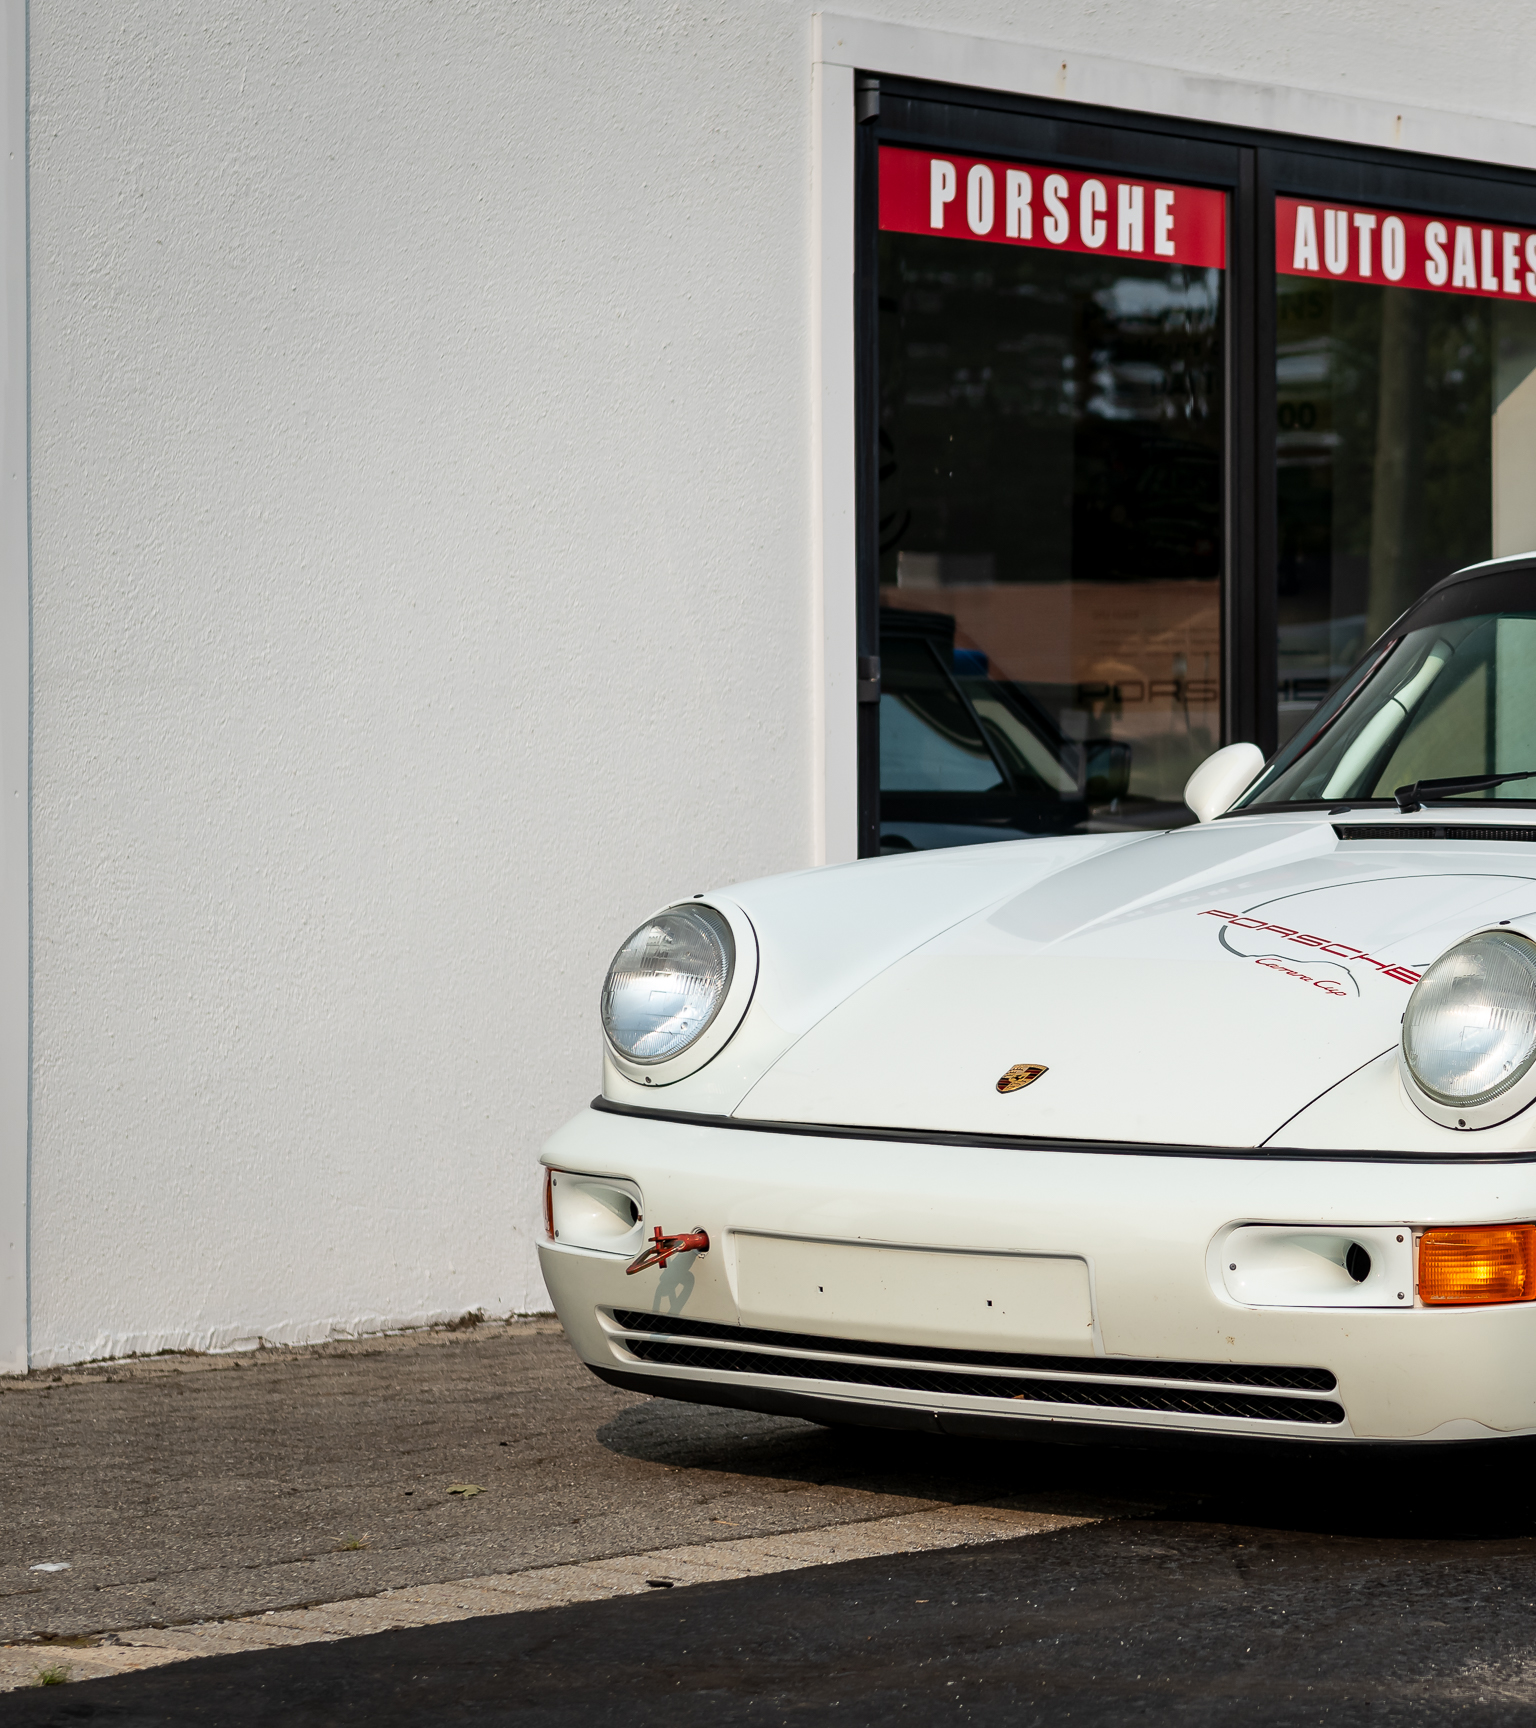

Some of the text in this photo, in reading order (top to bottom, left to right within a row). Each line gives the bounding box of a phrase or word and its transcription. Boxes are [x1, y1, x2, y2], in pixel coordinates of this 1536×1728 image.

[930, 160, 1176, 256] PORSCHE
[1294, 205, 1403, 281] AUTO
[1197, 909, 1421, 985] PORSCHE
[1255, 958, 1348, 997] Carrera Cup
